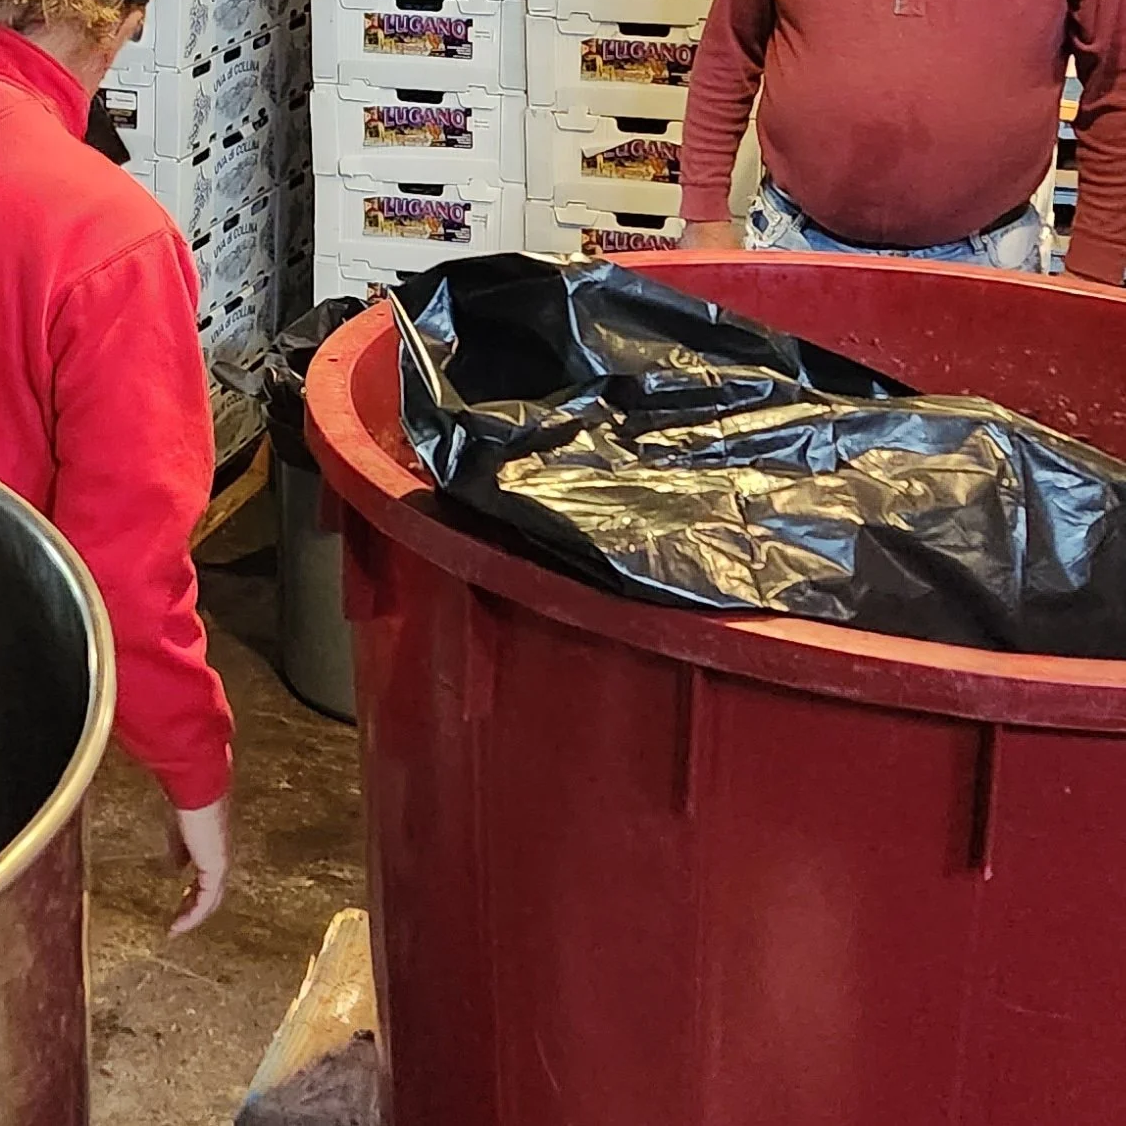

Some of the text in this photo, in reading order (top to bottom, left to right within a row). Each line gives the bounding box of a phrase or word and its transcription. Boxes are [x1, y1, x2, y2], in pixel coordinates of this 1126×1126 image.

[383, 14, 467, 39] LUGANO
[602, 40, 693, 64] LUGANO
[213, 74, 226, 92] UVA
[234, 61, 260, 74] COLLINA
[383, 106, 465, 130] LUGANO
[214, 157, 228, 175] UVA
[236, 140, 260, 156] COLLINA
[603, 139, 682, 160] UGAN
[383, 196, 465, 223] LUGANO
[602, 230, 676, 251] LUGAN
